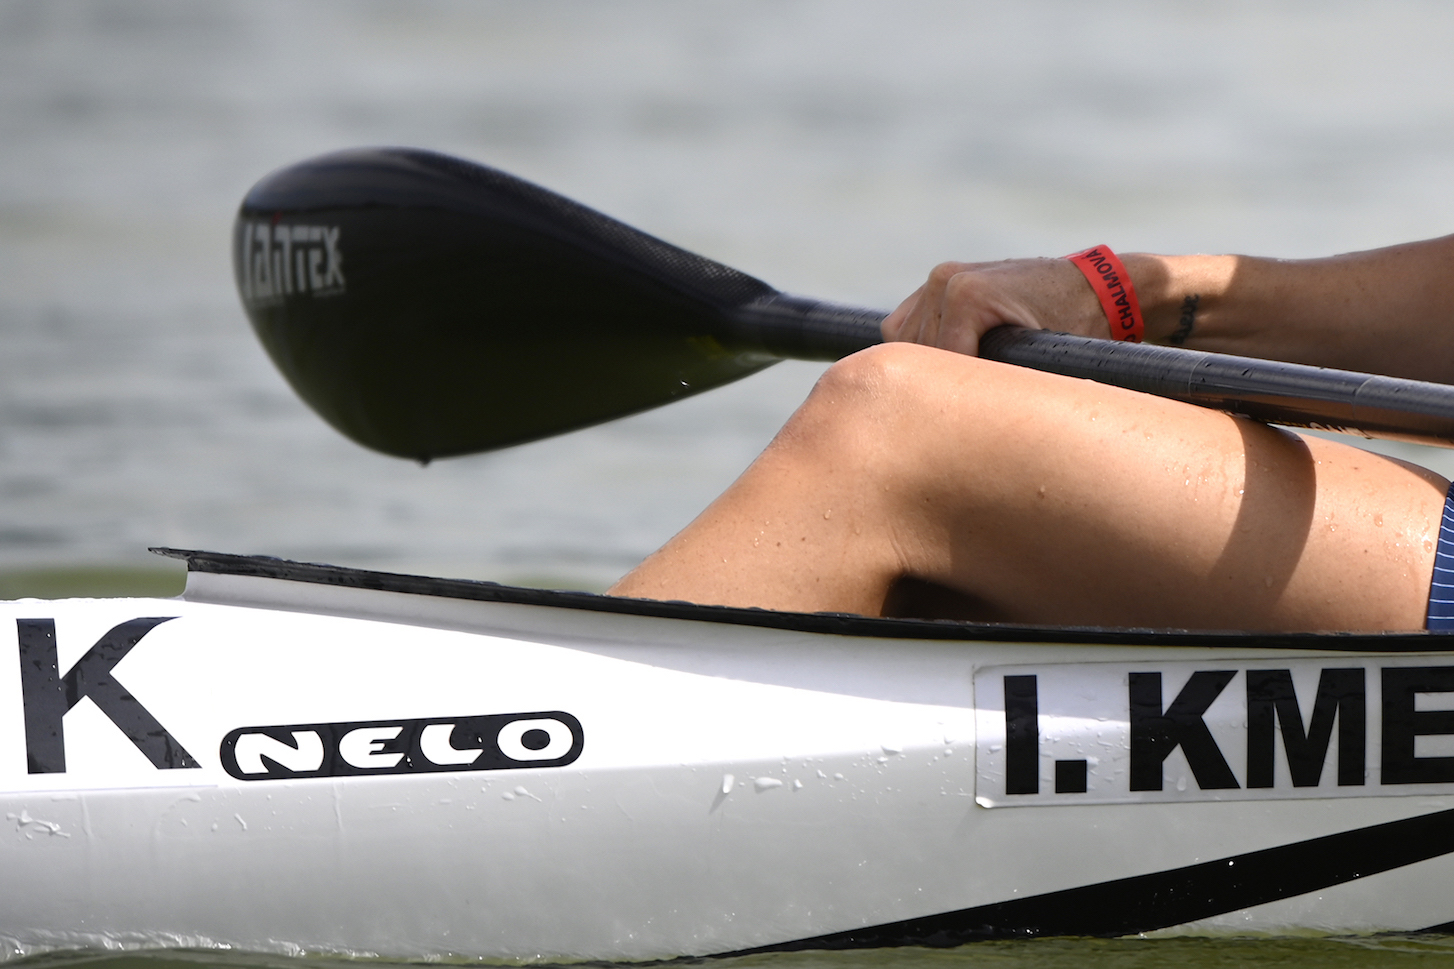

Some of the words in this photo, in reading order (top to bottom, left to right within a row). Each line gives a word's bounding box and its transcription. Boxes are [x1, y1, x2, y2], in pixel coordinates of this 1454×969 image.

[17, 616, 203, 774] K
[234, 717, 574, 775] NELO
[1003, 674, 1088, 795] I.
